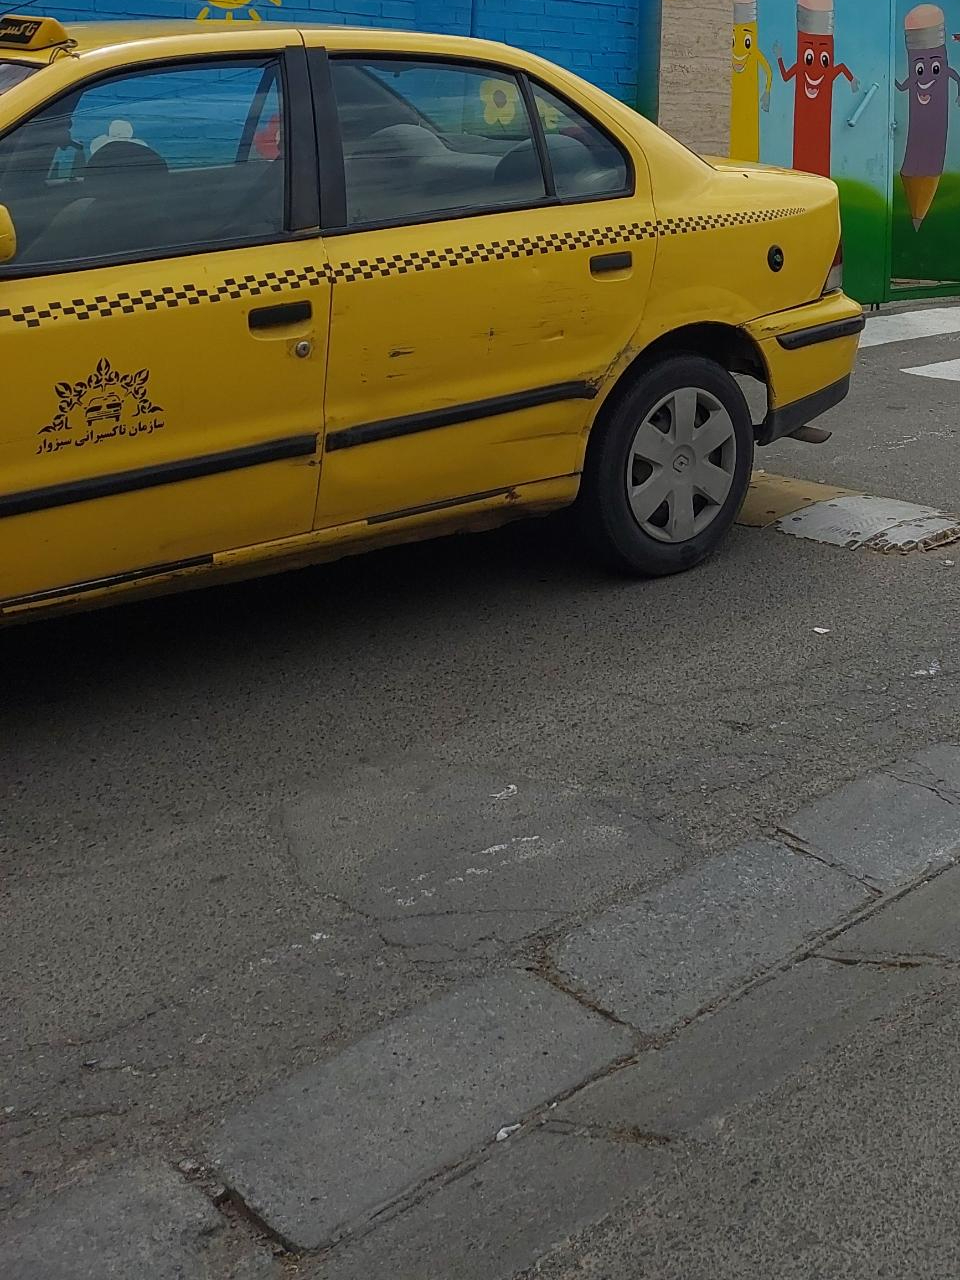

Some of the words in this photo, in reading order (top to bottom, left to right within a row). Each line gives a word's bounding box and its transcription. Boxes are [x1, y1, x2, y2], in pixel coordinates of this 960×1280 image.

[74, 424, 126, 447] تاکسیرانی
[128, 418, 165, 437] سازمان
[36, 437, 72, 455] سبزوار
